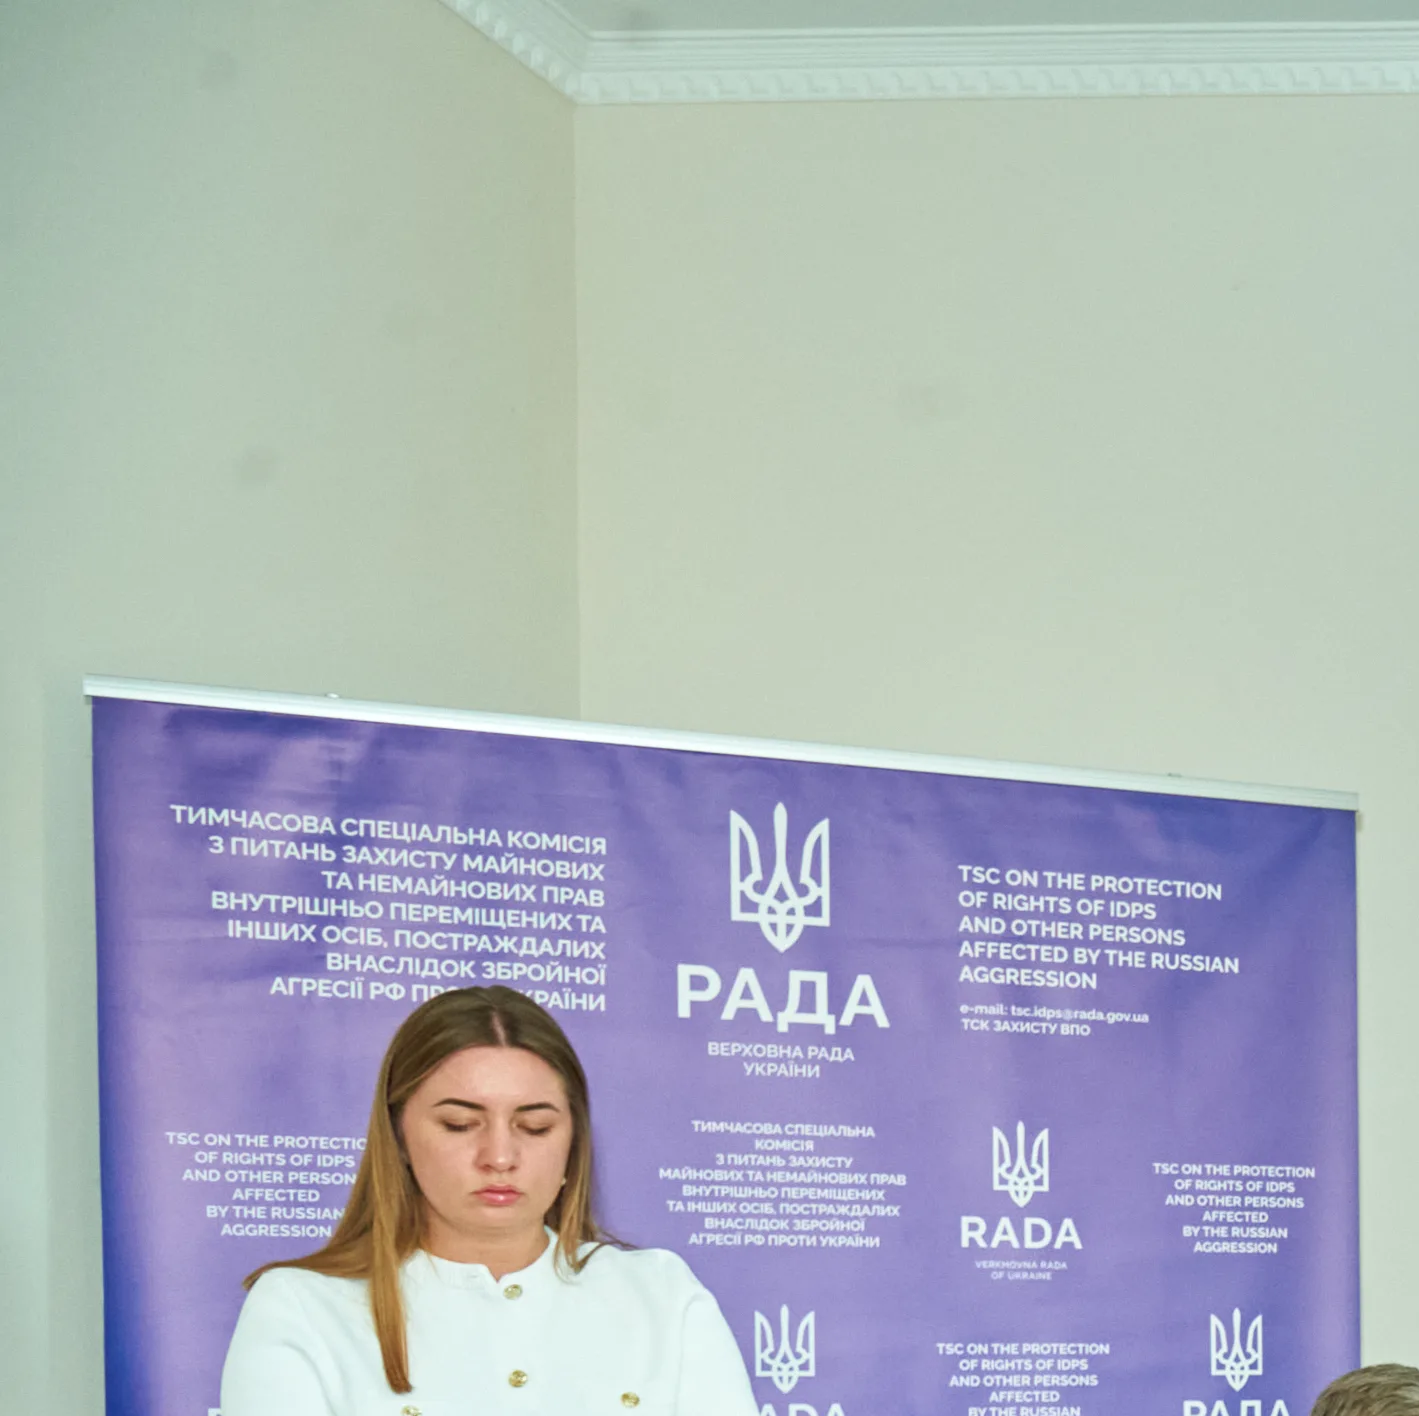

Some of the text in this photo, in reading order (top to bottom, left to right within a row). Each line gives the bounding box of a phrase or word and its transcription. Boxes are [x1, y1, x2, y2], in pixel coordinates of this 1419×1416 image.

[170, 804, 607, 856] ТИМЧАСОВА СПЕЦІАЛЬНА КОМІСІЯ
[208, 835, 605, 882] З ПИТАНЬ ЗАХИСТУ МАЙНОВИХ
[320, 870, 605, 908] ТА НЕМАЙНОВИХ ПРАВ
[957, 864, 1222, 901] TSC ON THE PROTECTION
[211, 890, 607, 934] ВНУТРІШНЬО ПЕРЕМІЩЕНИХ ТА
[958, 890, 1157, 920] OF RIGHTS OF IDPS
[228, 919, 317, 942] ІНШИХ
[394, 929, 606, 960] ПОСТРАЖДАЛИХ
[958, 915, 1186, 946] AND OTHER PERSONS
[958, 940, 1239, 974] AFFECTED BY THE RUSSIAN
[326, 952, 607, 986] ВНАСЛІДОК ЗБРОЙНОЇ
[958, 965, 1097, 989] AGGRESSION
[270, 976, 363, 1000] АГРЕСІЇ
[369, 981, 406, 1001] РФ
[677, 963, 890, 1035] РАДА
[959, 1003, 1149, 1024] e-mail: tsc.idps@rada.gov.ua
[961, 1017, 1091, 1036] ТСК ЗАХИСТУ ВПО
[707, 1041, 855, 1063] ВЕРХОВНА РАДА
[743, 1060, 820, 1078] УКРАЇНИ
[691, 1120, 876, 1138] ТИМЧАСОВА СПЕЦІАЛЬНА
[164, 1131, 367, 1151] TSC ON THE PROTECTIO
[754, 1138, 815, 1152] КОМІСІЯ
[194, 1150, 356, 1168] OF RIGHTS OF IDPS
[716, 1153, 853, 1169] З ПИТАНЬ ЗАХИСТУ
[181, 1168, 357, 1185] AND OTHER PERSON
[658, 1166, 907, 1186] МАЙНОВИХ ТА НЕМАЙНОВИХ ПРАВ
[1152, 1162, 1316, 1178] TSC ON THE PROTECTION
[232, 1187, 321, 1202] AFFECTED
[682, 1184, 885, 1201] ВНУТРІШНЬО ПЕРЕМІЩЕНИХ
[1174, 1178, 1296, 1193] OF RIGHTS OF IDPS
[666, 1200, 685, 1212] ТА
[686, 1201, 737, 1213] ІНШИХ
[779, 1202, 901, 1218] ПОСТРАЖДАЛИХ
[1164, 1194, 1305, 1209] AND OTHER PERSONS
[206, 1204, 345, 1220] BY THE RUSSIAN
[1202, 1210, 1269, 1223] AFFECTED
[220, 1223, 332, 1238] AGGRESSION
[704, 1217, 865, 1232] ВНАСЛІДОК ЗБРОЙНОЇ
[1182, 1225, 1288, 1239] BY THE RUSSIAN
[688, 1232, 881, 1248] АГРЕСІЇ РФ ПРОТИ УКРАЇНИ
[1193, 1241, 1278, 1254] AGGRESSION
[936, 1342, 1110, 1355] TSC ON THE PROTECTION
[958, 1358, 1089, 1371] OF RIGHTS OF IDPS
[949, 1374, 1099, 1387] AND OTHER PERSONS
[989, 1390, 1061, 1403] AFFECTED
